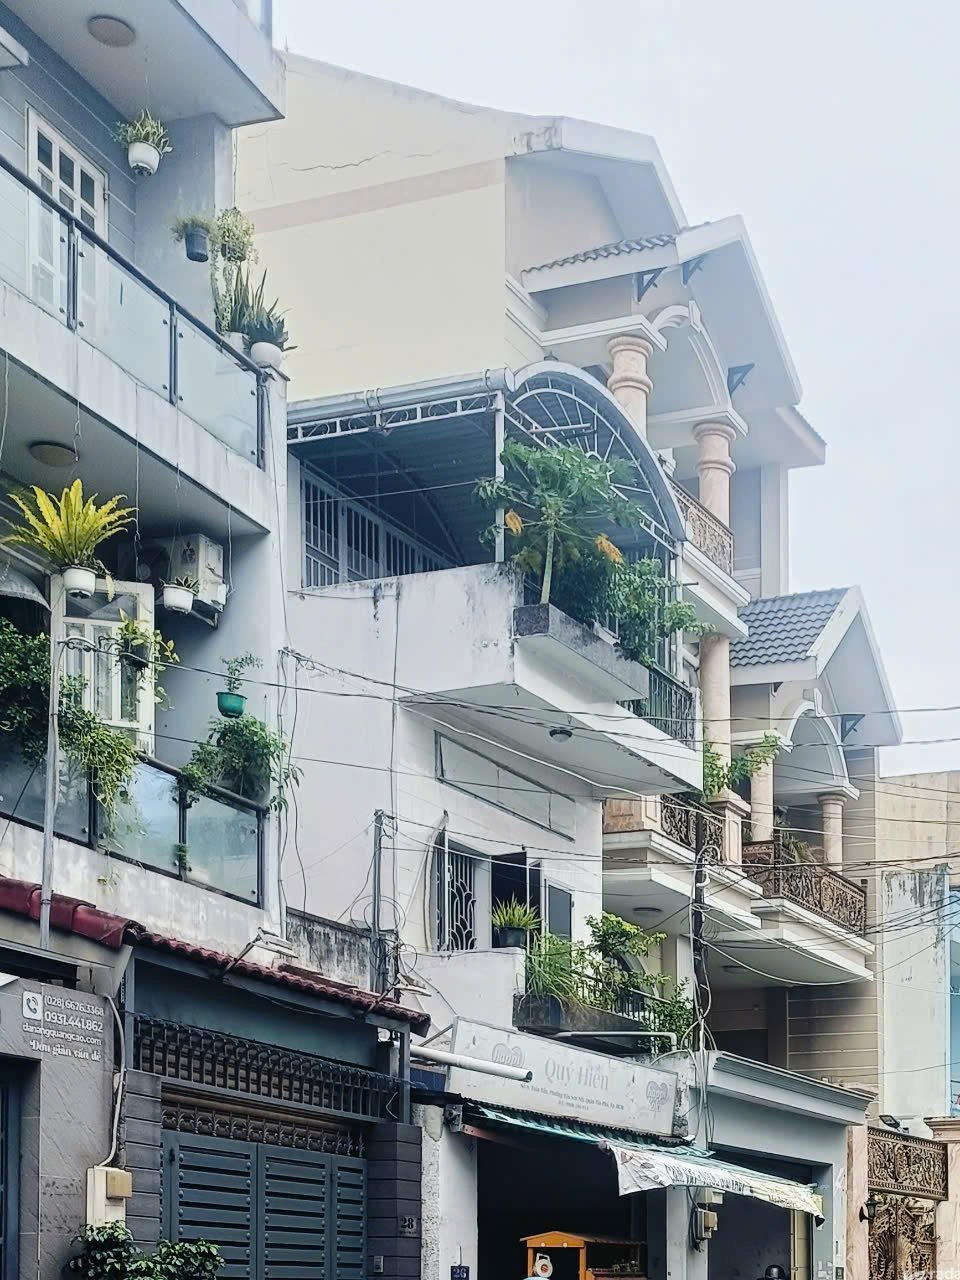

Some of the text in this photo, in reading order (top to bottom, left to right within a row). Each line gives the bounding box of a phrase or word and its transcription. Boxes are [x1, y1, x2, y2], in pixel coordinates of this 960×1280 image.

[44, 1011, 104, 1033] 0931.441.862
[22, 1022, 102, 1046] danangquangcao.com
[400, 1217, 414, 1229] 28
